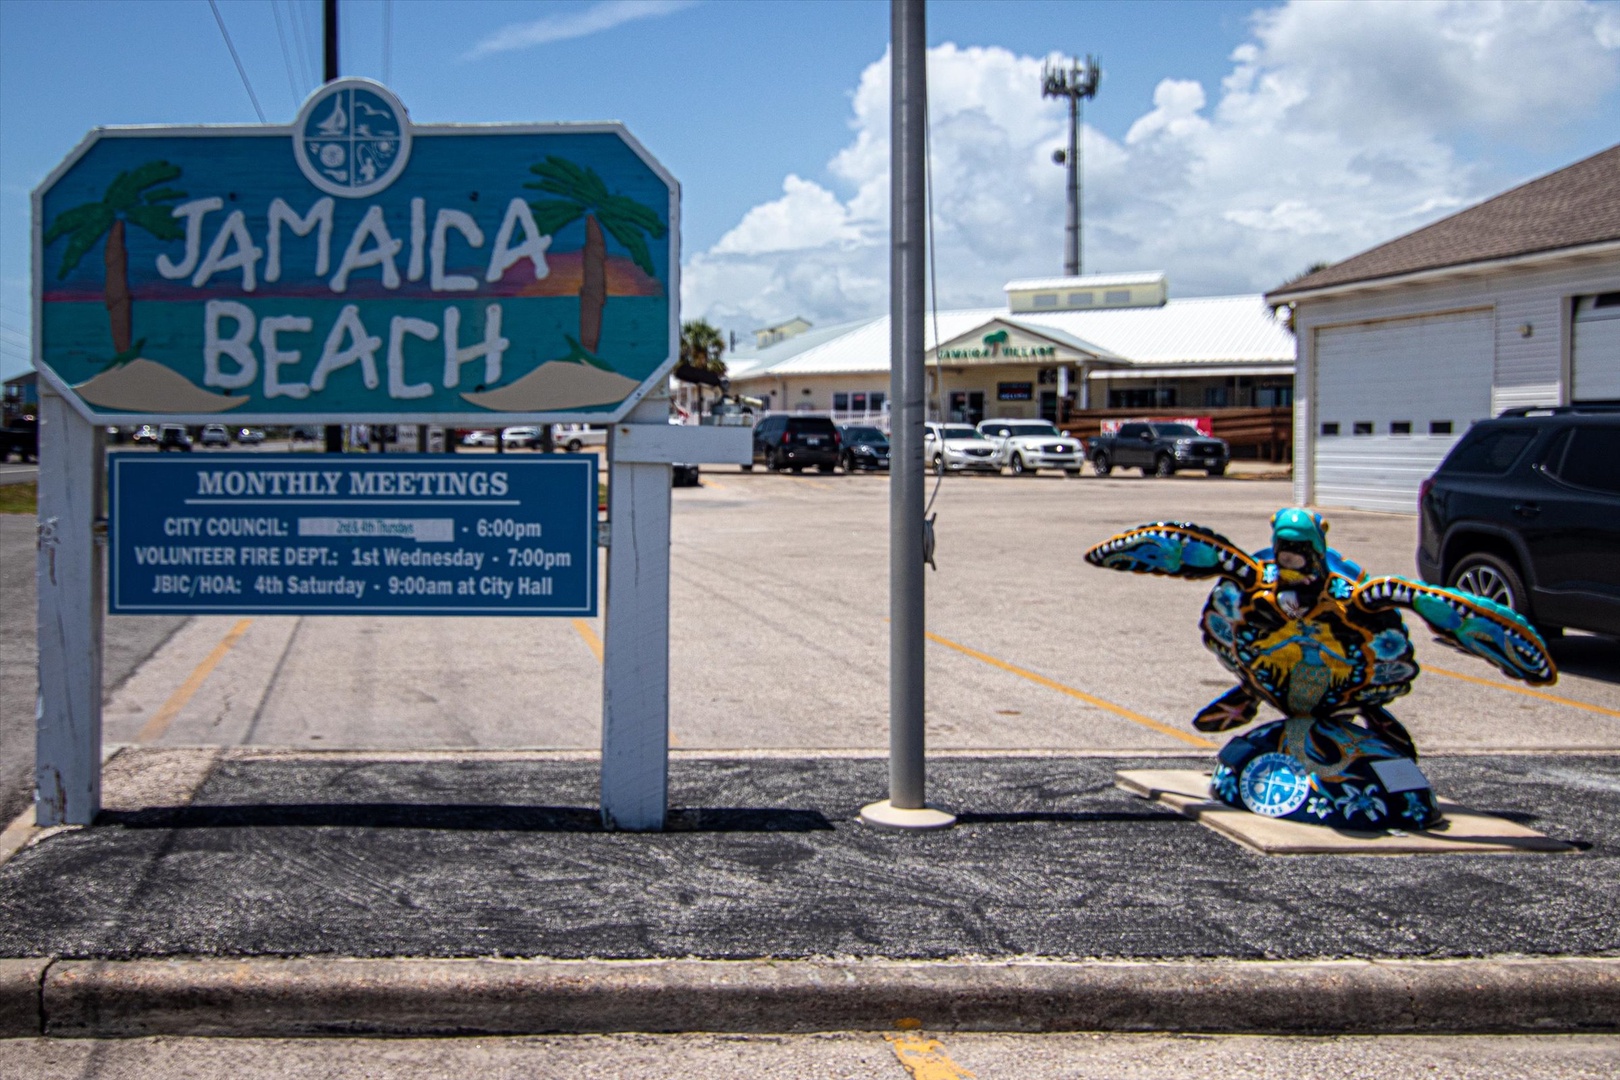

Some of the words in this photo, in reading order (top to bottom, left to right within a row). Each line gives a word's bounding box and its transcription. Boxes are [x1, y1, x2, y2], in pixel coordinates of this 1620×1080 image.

[156, 197, 552, 293] JAMAICA
[204, 300, 509, 398] BEACH
[197, 471, 342, 495] MONTHLY
[348, 471, 509, 496] MEETINGS
[164, 518, 202, 536] CITY
[206, 518, 288, 536] COUNCIL:
[476, 518, 542, 541] 6:00pm
[134, 547, 236, 566] VOLUNTEER
[240, 548, 281, 566] FIRE
[284, 548, 338, 566] DEPT.:
[351, 548, 380, 567] 1st
[383, 548, 485, 571] Wednesday
[507, 548, 572, 571] 7:00pm
[152, 575, 242, 598] JBIC/HOA:
[254, 576, 284, 595] 4th
[287, 576, 366, 599] Saturday
[388, 577, 453, 595] 9:00am
[457, 579, 476, 596] at
[479, 577, 514, 600] City
[517, 577, 553, 596] Hall
